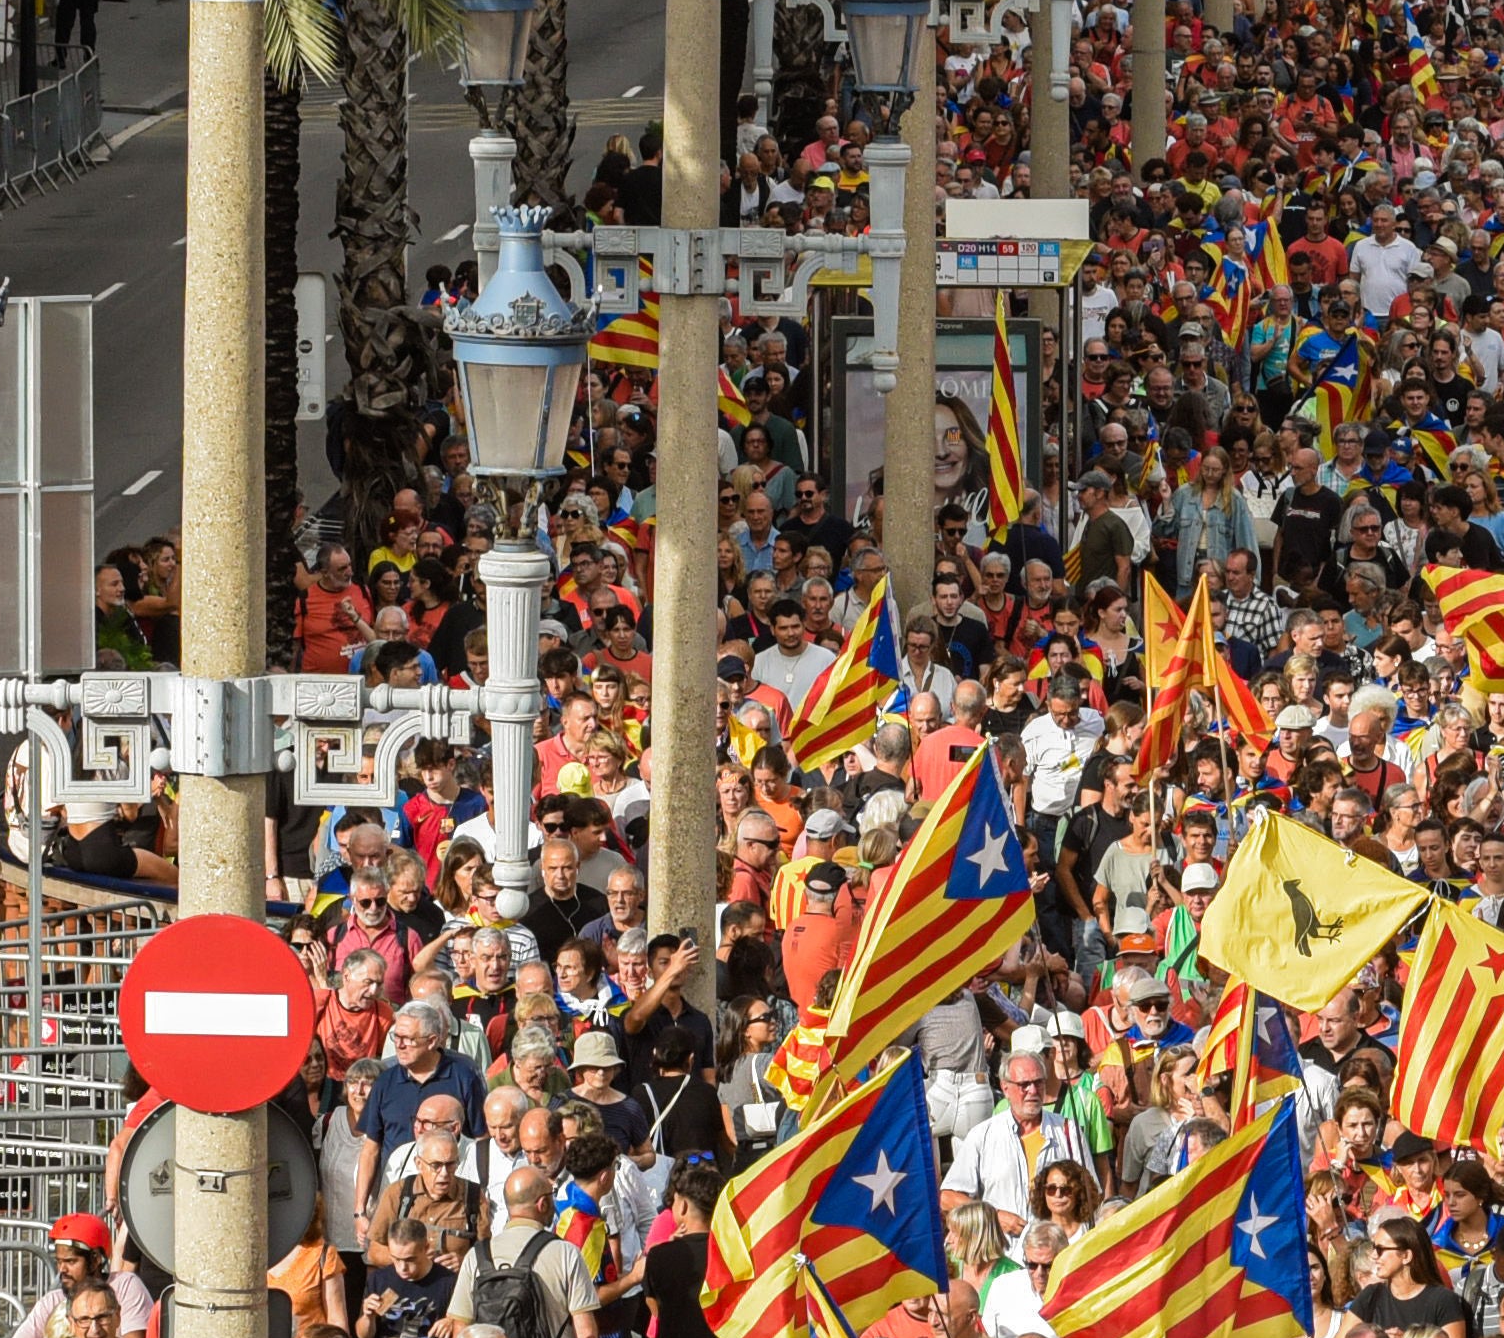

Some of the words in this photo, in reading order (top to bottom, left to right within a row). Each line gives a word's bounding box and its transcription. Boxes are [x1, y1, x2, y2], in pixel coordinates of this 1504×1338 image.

[958, 243, 977, 252] D20
[979, 243, 996, 252] H14
[1022, 243, 1036, 251] 120
